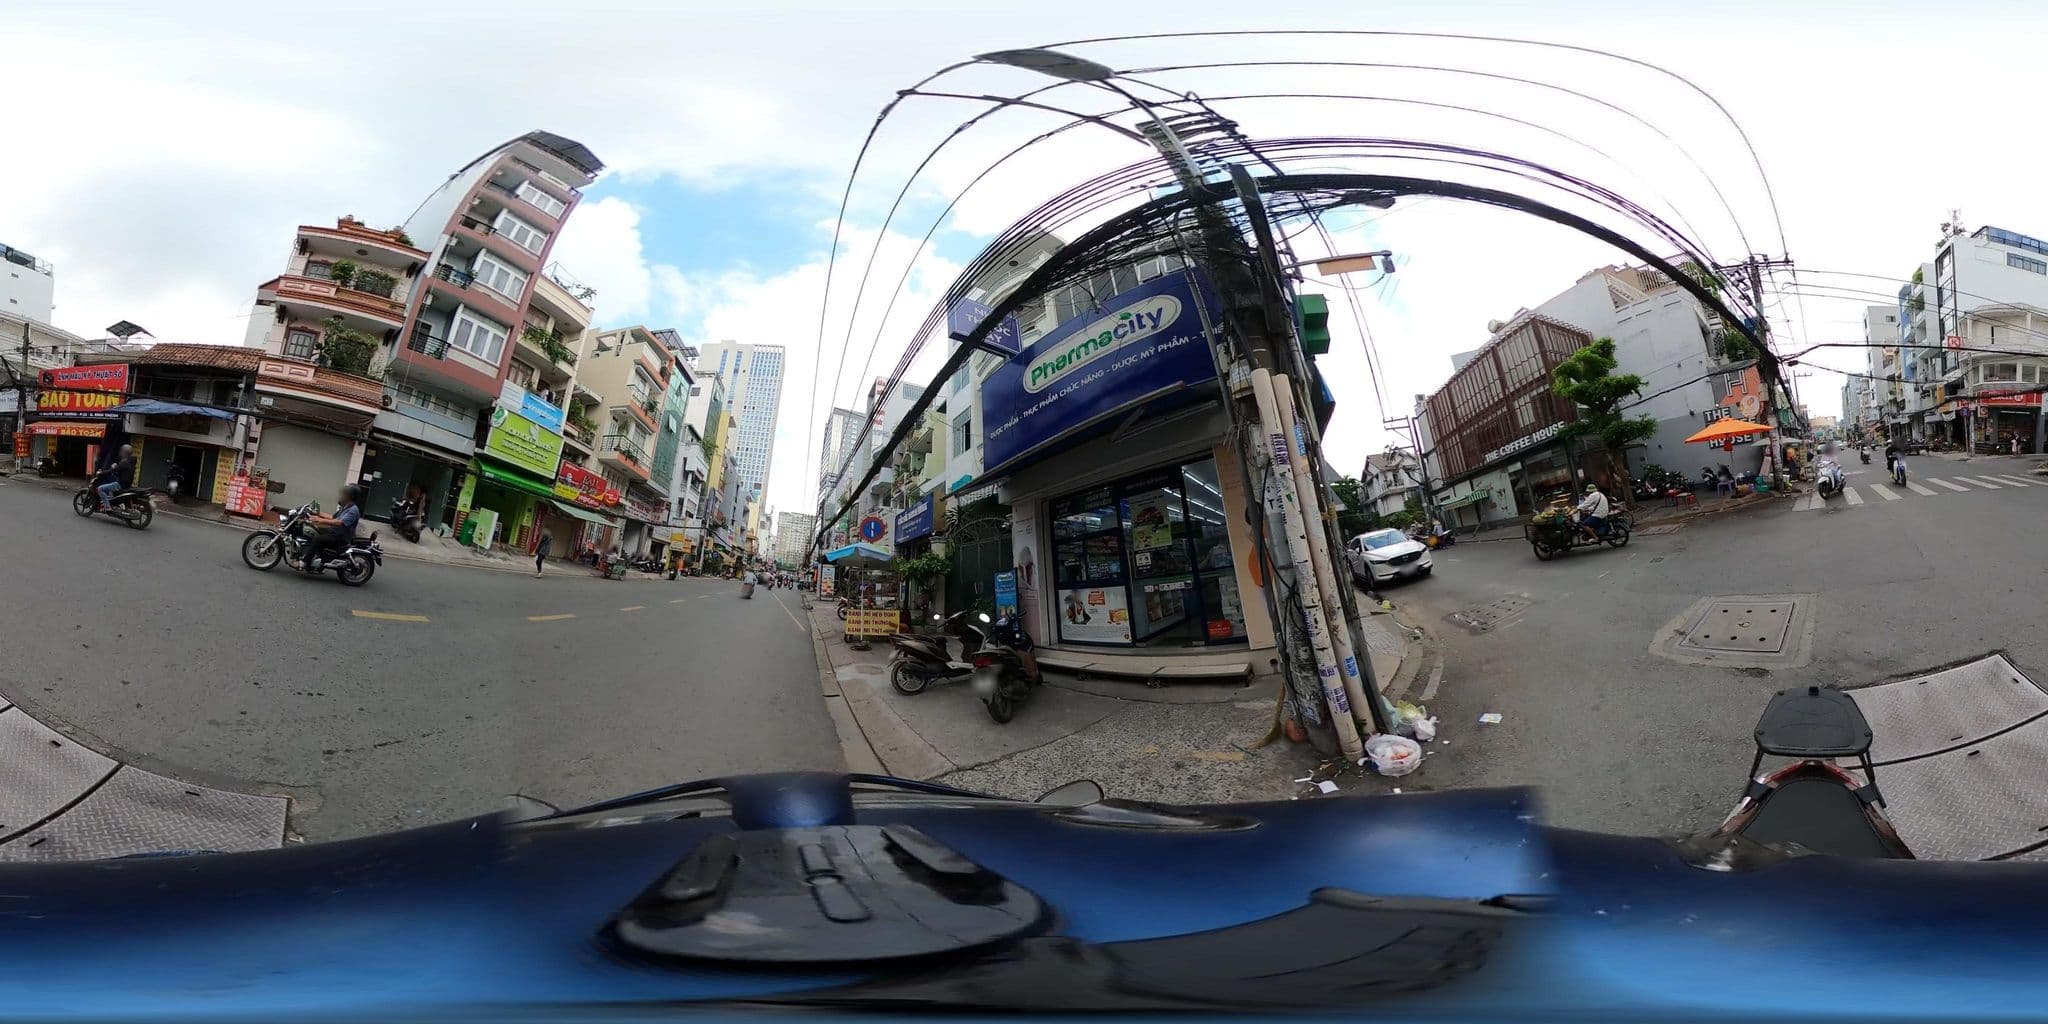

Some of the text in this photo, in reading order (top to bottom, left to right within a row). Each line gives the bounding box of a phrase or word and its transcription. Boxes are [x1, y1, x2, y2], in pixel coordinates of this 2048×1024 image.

[1039, 392, 1059, 409] PHẨM
[1059, 380, 1080, 397] CHỨC
[1080, 369, 1105, 387] NĂNG
[1111, 354, 1139, 372] DƯỢC
[1140, 346, 1156, 360] MỸ
[1157, 335, 1190, 353] PHẨM
[1704, 407, 1731, 422] THE
[1485, 420, 1565, 463] THE COFFEE HOUSE
